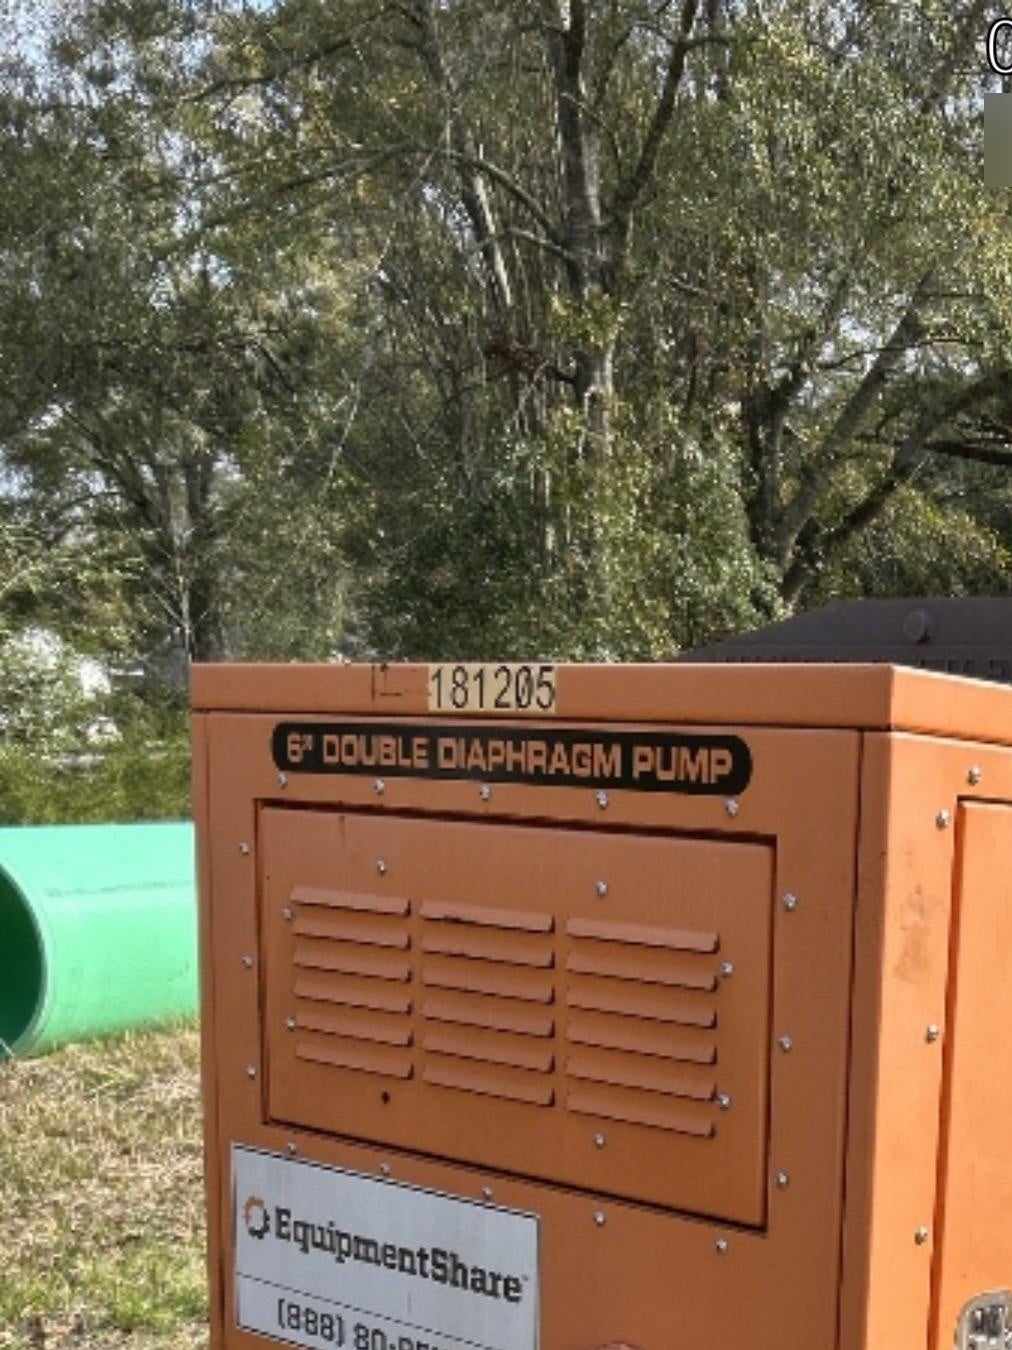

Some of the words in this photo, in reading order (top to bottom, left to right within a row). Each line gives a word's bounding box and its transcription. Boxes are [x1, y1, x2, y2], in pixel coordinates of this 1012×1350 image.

[431, 665, 557, 709] 181205
[322, 734, 430, 769] DOUBLE
[437, 737, 622, 779] DIAPHRAGM
[631, 745, 734, 785] PUMP
[275, 1205, 523, 1303] EquipmentShare
[277, 1297, 345, 1348] (888)
